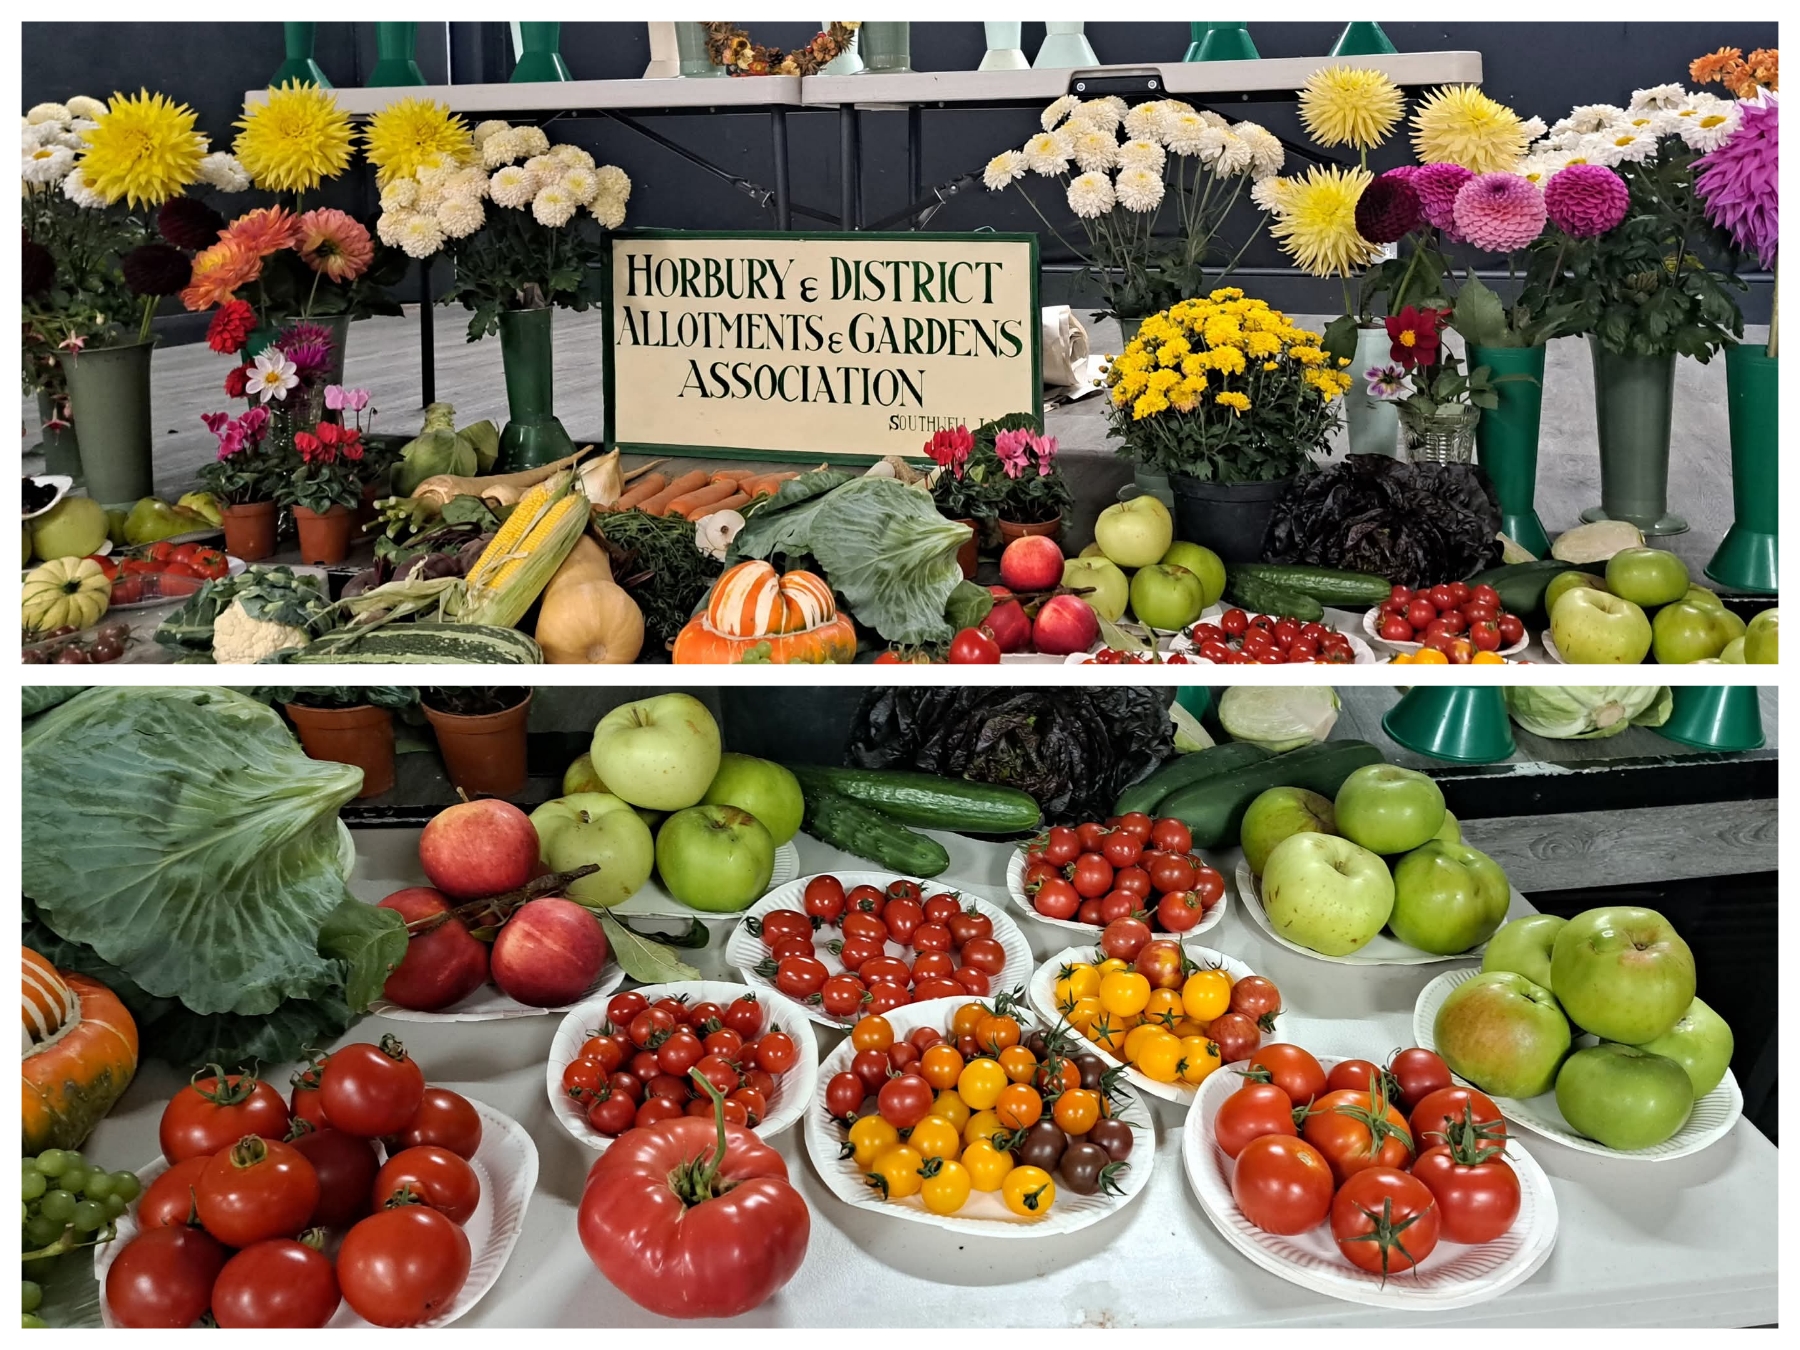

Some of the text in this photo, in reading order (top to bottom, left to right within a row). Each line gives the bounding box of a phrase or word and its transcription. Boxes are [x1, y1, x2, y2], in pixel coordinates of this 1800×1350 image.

[626, 254, 794, 300] HORBURY
[830, 256, 1003, 304] DISTRICT
[616, 306, 824, 352] ALLOTMENTS
[848, 312, 1023, 358] GARDENS
[677, 359, 926, 408] ASSOCIATION
